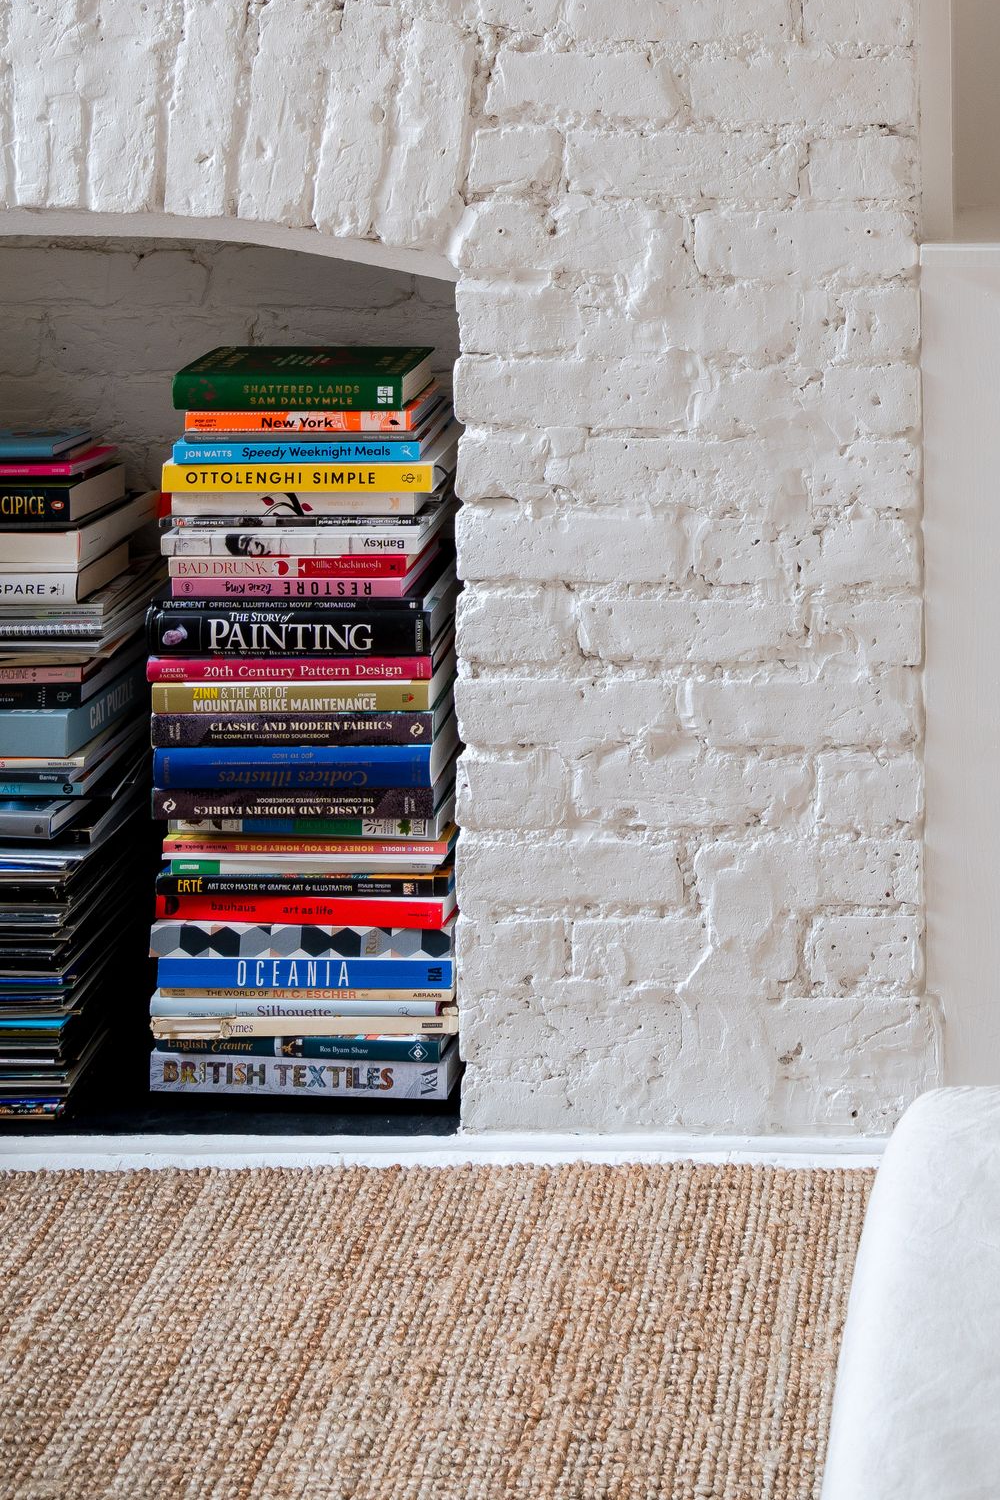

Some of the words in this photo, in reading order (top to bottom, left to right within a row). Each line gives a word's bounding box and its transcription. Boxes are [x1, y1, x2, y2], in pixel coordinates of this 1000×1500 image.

[243, 385, 313, 394] SHATTERED
[319, 385, 360, 394] LANDS
[250, 397, 276, 405] SAM
[280, 397, 353, 405] DALRYMPLE
[261, 417, 295, 429] New
[298, 417, 333, 429] York
[184, 451, 201, 460] JON
[204, 450, 232, 458] WATTS
[242, 448, 287, 460] Speedy
[289, 446, 352, 459] Weeknight
[355, 445, 391, 457] Meals
[185, 471, 302, 484] OTTOLENGHI
[312, 471, 376, 484] SIMPLE
[0, 496, 45, 515] CIPICE
[363, 538, 405, 549] Banksy
[178, 562, 209, 574] BAD
[212, 562, 268, 574] DRUNK
[311, 560, 333, 569] Millie
[335, 560, 382, 569] Mackintosh
[284, 581, 372, 596] RESTORE
[229, 612, 248, 621] THE
[280, 611, 294, 622] of
[208, 619, 374, 651] PAINTING
[203, 665, 234, 677] 20th
[238, 665, 295, 678] Century
[300, 665, 350, 676] Pattern
[355, 664, 402, 677] Design
[193, 687, 218, 699] ZINN
[220, 687, 229, 698] &
[230, 687, 251, 698] THE
[253, 687, 273, 698] ART
[274, 687, 288, 698] OF
[193, 699, 258, 712] MOUNTAIN
[260, 699, 288, 711] BIKE
[291, 698, 377, 711] MAINTENANCE
[89, 700, 105, 730] CAT
[210, 722, 259, 732] CLASSIC
[263, 722, 288, 731] AND
[291, 722, 345, 731] MODERN
[347, 721, 393, 730] FABRICS
[177, 876, 203, 893] ERTÉ
[211, 902, 257, 913] bauhaus
[282, 905, 299, 915] art
[301, 907, 313, 915] as
[315, 905, 333, 915] life
[237, 960, 350, 987] OCEANIA
[272, 990, 288, 999] M.
[290, 990, 303, 999] C.
[305, 990, 357, 999] ESCHER
[333, 1046, 350, 1055] Byam
[163, 1060, 267, 1087] BRITISH
[274, 1063, 394, 1091] TEXTILES
[420, 1068, 438, 1096] V&A
